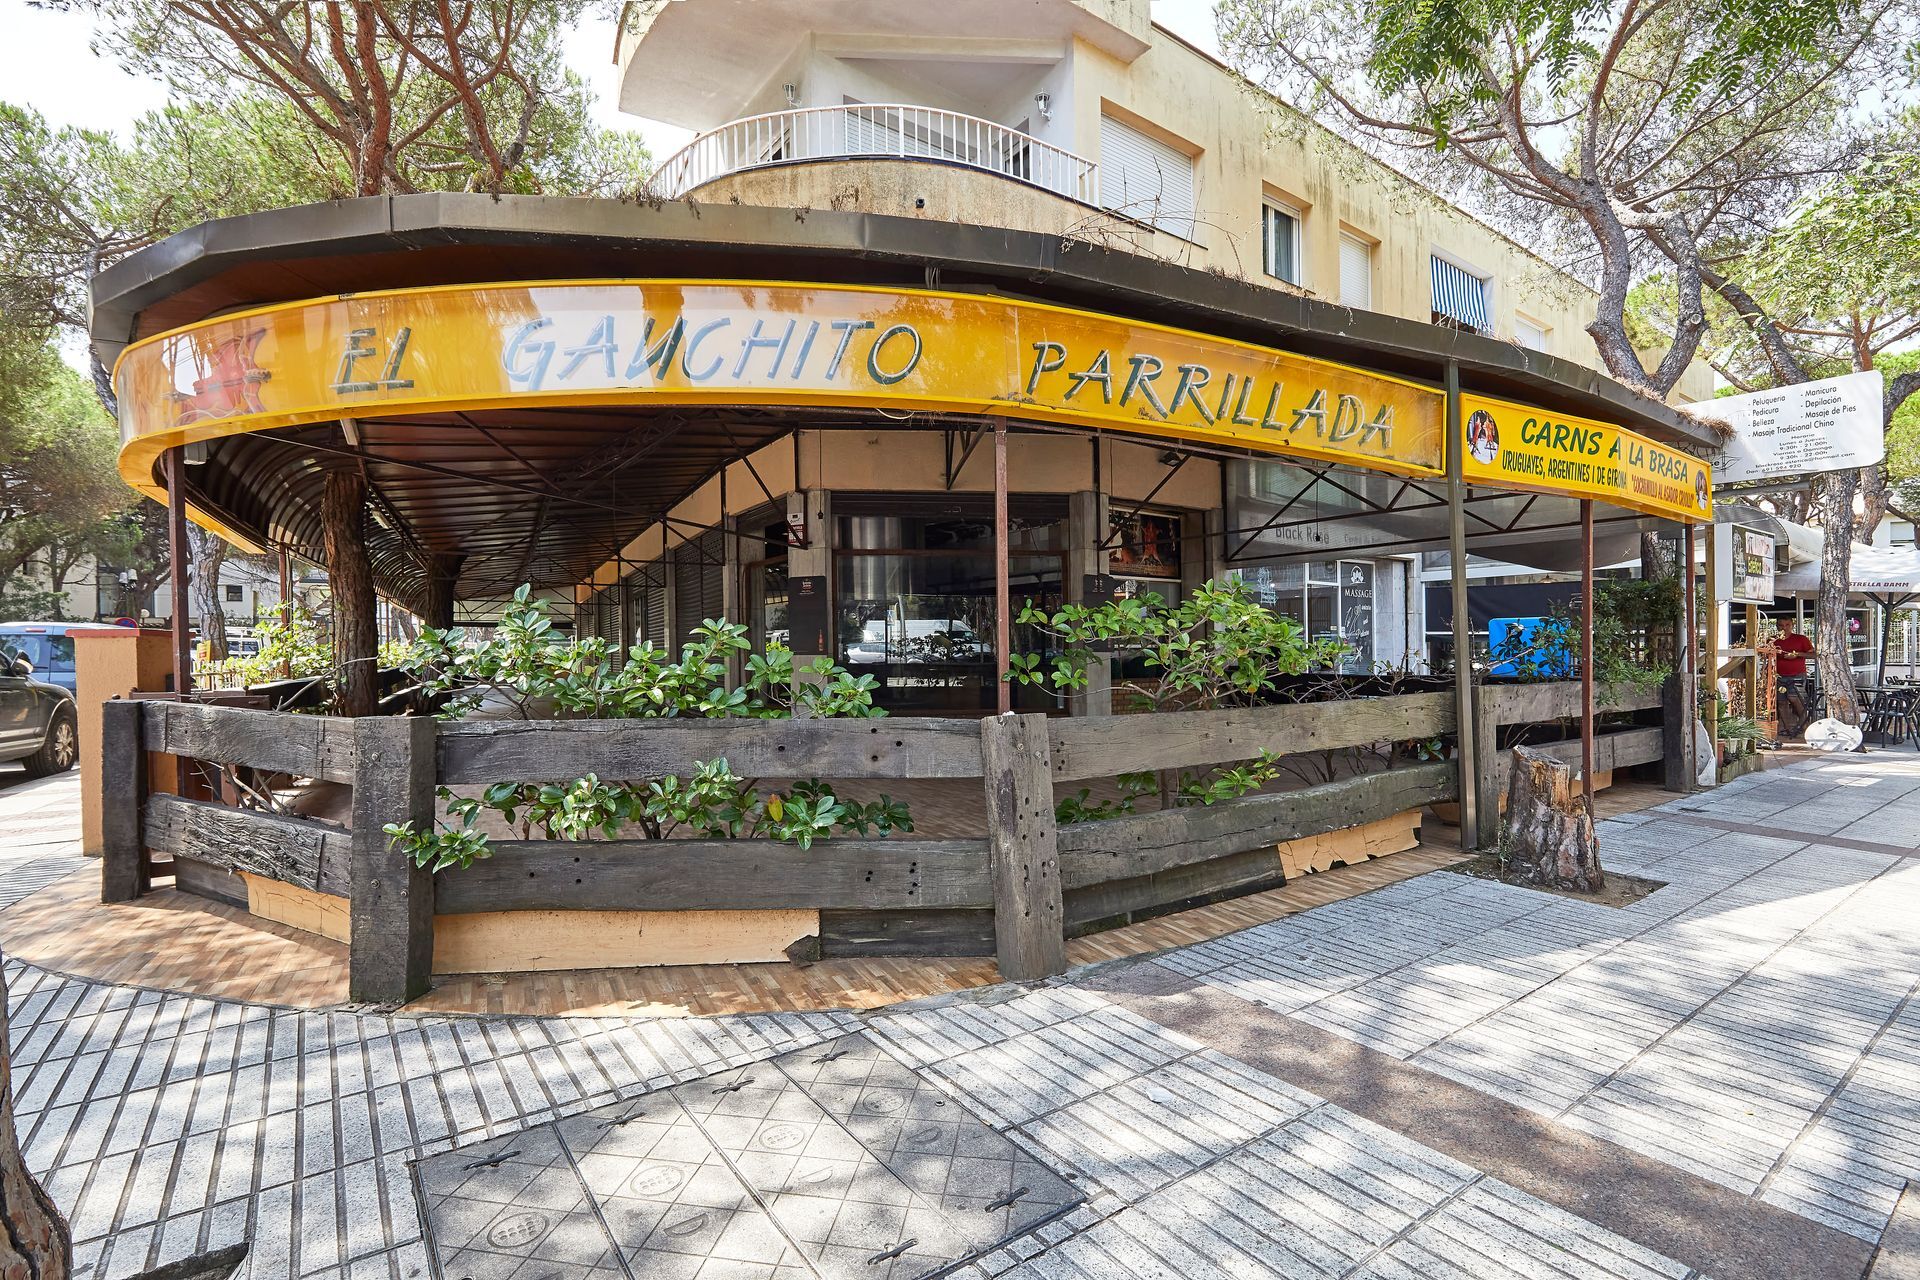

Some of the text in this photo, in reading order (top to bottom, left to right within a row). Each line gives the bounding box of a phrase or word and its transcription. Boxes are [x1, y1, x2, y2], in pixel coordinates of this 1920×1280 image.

[329, 315, 923, 395] EL GAUCHITO
[1026, 341, 1395, 449] PARRILLADA
[1805, 386, 1837, 397] Manicura
[1752, 407, 1779, 417] Pedicura
[1805, 405, 1857, 419] Masaje de Pies
[1752, 418, 1775, 428] Belleza
[1752, 419, 1835, 438] Masaje Tradicional Chino
[1521, 418, 1689, 484] CARNS A LA BRASA
[1502, 449, 1545, 480] URUGUAYES,
[1547, 458, 1590, 483] ARGENTINES
[1596, 466, 1606, 486] DE
[1345, 588, 1373, 598] MASSAGE
